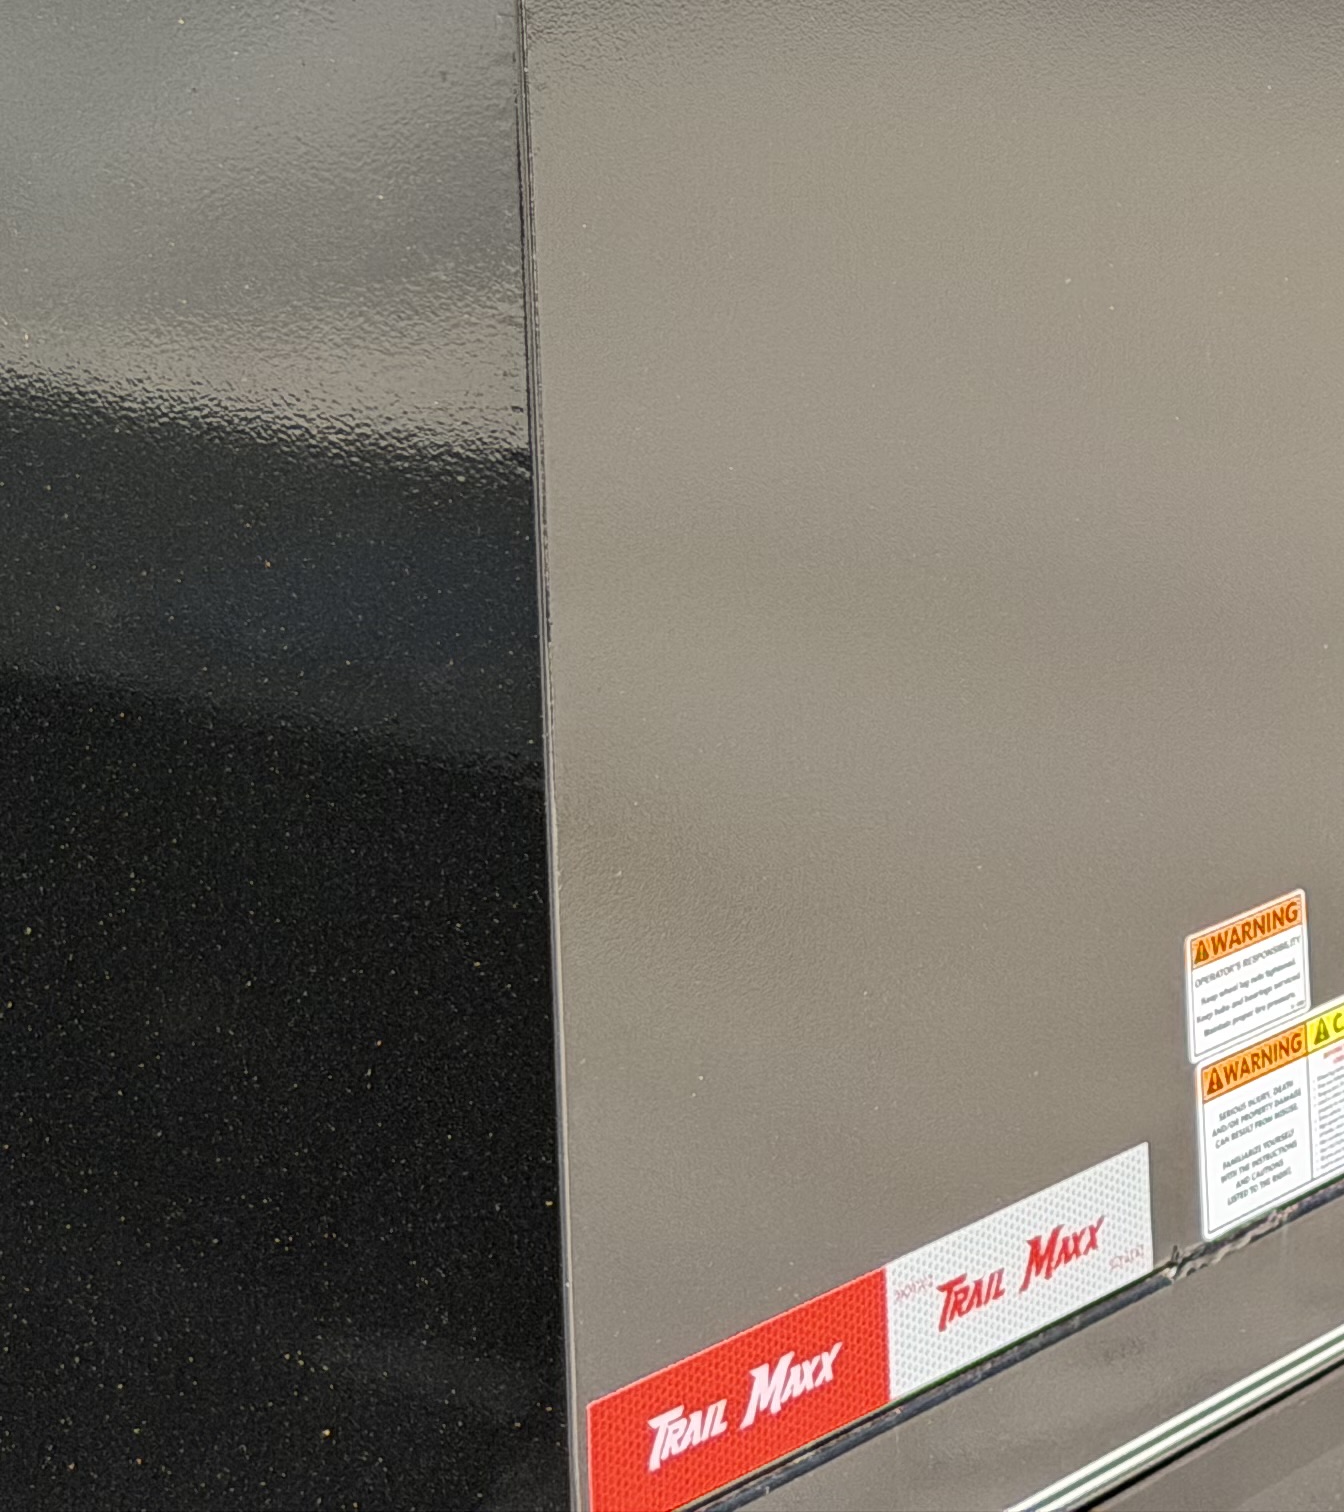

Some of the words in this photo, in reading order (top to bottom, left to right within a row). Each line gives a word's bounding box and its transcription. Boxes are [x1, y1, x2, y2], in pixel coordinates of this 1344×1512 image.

[1211, 901, 1298, 956] WARNING
[1223, 1033, 1302, 1085] WARNING
[937, 1268, 1005, 1332] TRAIL
[1019, 1215, 1104, 1292] MAXX
[648, 1398, 728, 1472] TRAIL
[740, 1341, 843, 1429] MAXX
